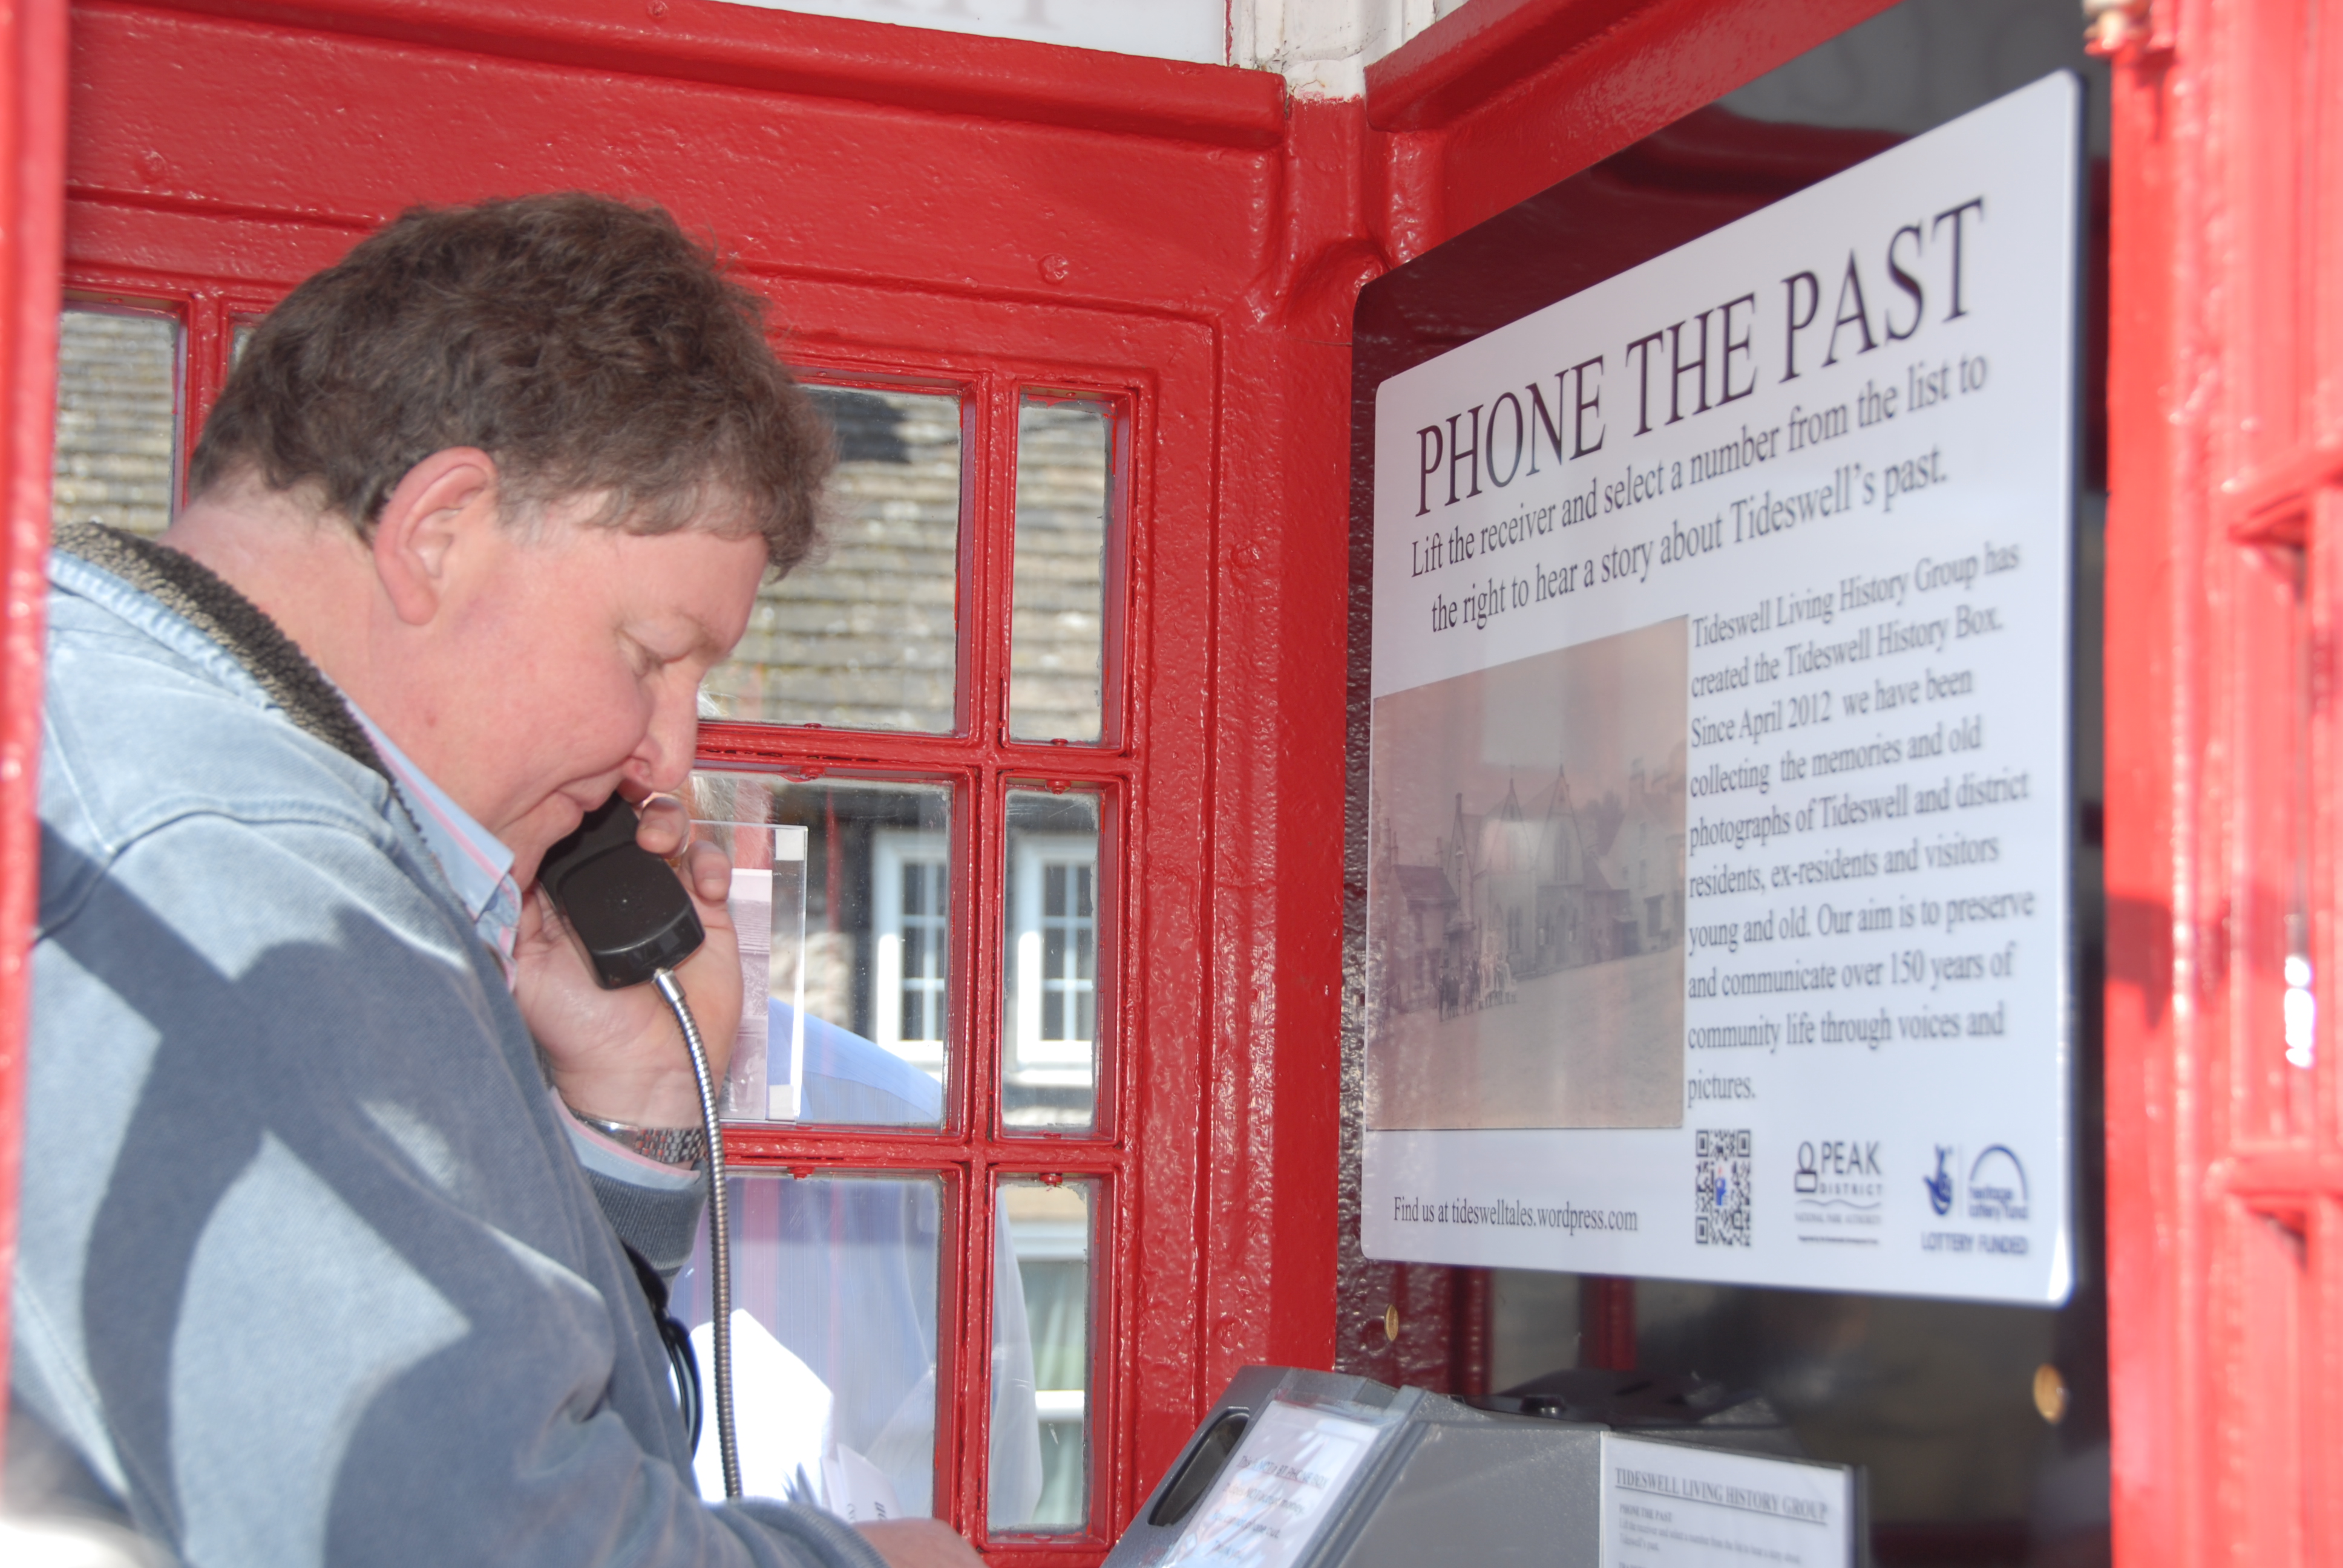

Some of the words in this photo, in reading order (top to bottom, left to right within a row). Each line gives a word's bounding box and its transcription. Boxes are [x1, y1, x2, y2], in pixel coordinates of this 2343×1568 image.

[1415, 355, 1605, 517] PHONE
[1626, 292, 1755, 437] THE
[1779, 197, 1984, 383] PAST
[1412, 532, 1443, 577] Lift
[1449, 526, 1474, 564] the
[1480, 503, 1556, 554] receiver
[1562, 477, 1598, 528] and
[1604, 463, 1664, 513] select
[1671, 461, 1683, 491] a
[1690, 427, 1780, 485] number
[1788, 403, 1849, 452] from
[1857, 386, 1898, 428] the
[1907, 363, 1950, 413] list
[1958, 356, 1988, 394] to
[1432, 594, 1457, 632] the
[1463, 578, 1506, 627] right
[1512, 577, 1529, 609] to
[1535, 563, 1578, 602] hear
[1584, 560, 1594, 588] a
[1602, 541, 1653, 583] story
[1660, 514, 1723, 565] about
[1730, 470, 1876, 543] Tideswell’s
[1883, 449, 1947, 513] past.
[1693, 599, 1771, 647] Tideswell
[1776, 589, 1834, 628] Living
[1839, 573, 1909, 612] History
[1914, 555, 1979, 593] Group
[1984, 542, 2020, 576] has
[1692, 656, 1749, 697] created
[1754, 652, 1780, 684] the
[1784, 628, 1871, 677] Tideswell
[1876, 618, 1949, 657] History
[1955, 604, 2004, 639] Box.
[1692, 716, 1735, 748] Since
[1738, 700, 1783, 741] April
[1788, 690, 1831, 729] 2012
[1843, 691, 1870, 716] we
[1875, 681, 1921, 711] have
[1926, 670, 1973, 702] been
[1691, 758, 1770, 797] collecting
[1780, 750, 1807, 782] the
[1812, 733, 1902, 777] memories
[1907, 722, 1944, 760] and
[1948, 714, 1983, 754] old
[1690, 806, 1791, 856] photographs
[1795, 803, 1817, 832] of
[1818, 791, 1909, 829] Tideswell
[1914, 785, 1951, 815] and
[1955, 769, 2030, 809] district
[1690, 864, 1766, 897] residents,
[1771, 849, 1879, 889] ex-residents
[1884, 841, 1919, 875] and
[1924, 832, 2000, 868] visitors
[1689, 923, 1738, 956] young
[1743, 910, 1774, 943] and
[1778, 908, 1811, 940] old.
[1817, 904, 1854, 936] Our
[1858, 900, 1893, 932] aim
[1899, 895, 1916, 929] is
[1920, 899, 1941, 926] to
[1946, 890, 2036, 934] preserve
[1689, 967, 1717, 998] and
[1722, 959, 1837, 997] communicate
[1841, 962, 1884, 988] over
[1891, 949, 1926, 985] 150
[1930, 954, 1985, 990] years
[1989, 940, 2017, 979] of
[1688, 1014, 1781, 1054] community
[1786, 1011, 1816, 1045] life
[1820, 1008, 1893, 1050] through
[1898, 1005, 1962, 1040] voices
[1965, 1001, 2006, 1038] and
[1688, 1070, 1755, 1108] pictures.
[1819, 1183, 1882, 1196] DISTRICT
[1821, 1141, 1881, 1175] PEAK
[1394, 1196, 1418, 1222] Find
[1423, 1205, 1434, 1223] us
[1438, 1202, 1448, 1223] at
[1452, 1197, 1637, 1236] tideswelltales.wordpress.com
[1922, 1232, 1975, 1253] LOTTERY
[1978, 1235, 2029, 1256] FUNDED
[1276, 1465, 1288, 1477] BT
[1312, 1474, 1331, 1488] BOX
[1615, 1468, 1679, 1494] TIDESWELL
[1682, 1478, 1723, 1501] LIVING
[1725, 1486, 1779, 1511] HISTORY
[1782, 1495, 1828, 1520] GROUP
